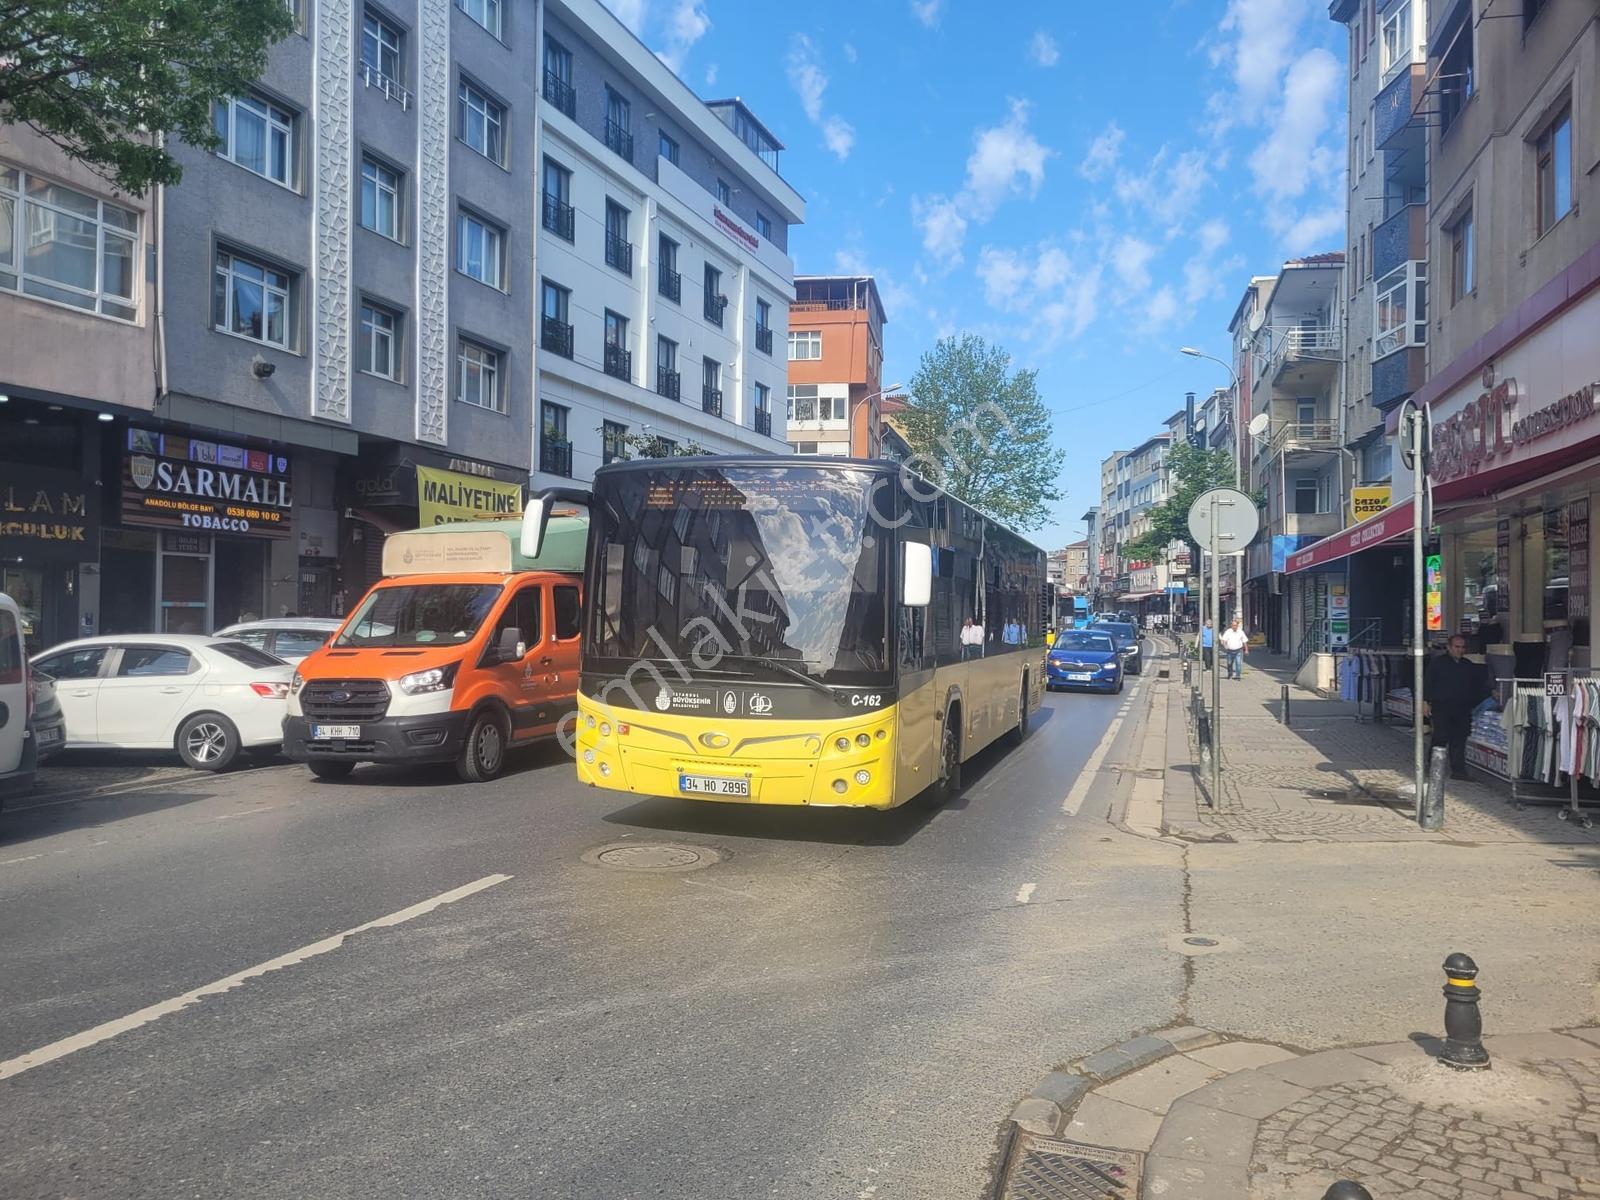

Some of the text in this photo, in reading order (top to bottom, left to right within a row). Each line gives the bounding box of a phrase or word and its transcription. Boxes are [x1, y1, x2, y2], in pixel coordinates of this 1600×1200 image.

[157, 462, 293, 507] SARMALL
[145, 498, 177, 509] ANADOLU
[424, 480, 515, 512] MALİYETİNE
[182, 513, 250, 532] TOBACCO
[1547, 684, 1564, 695] 500
[851, 694, 882, 706] C-162
[686, 778, 698, 790] 34
[722, 781, 747, 794] 2896
